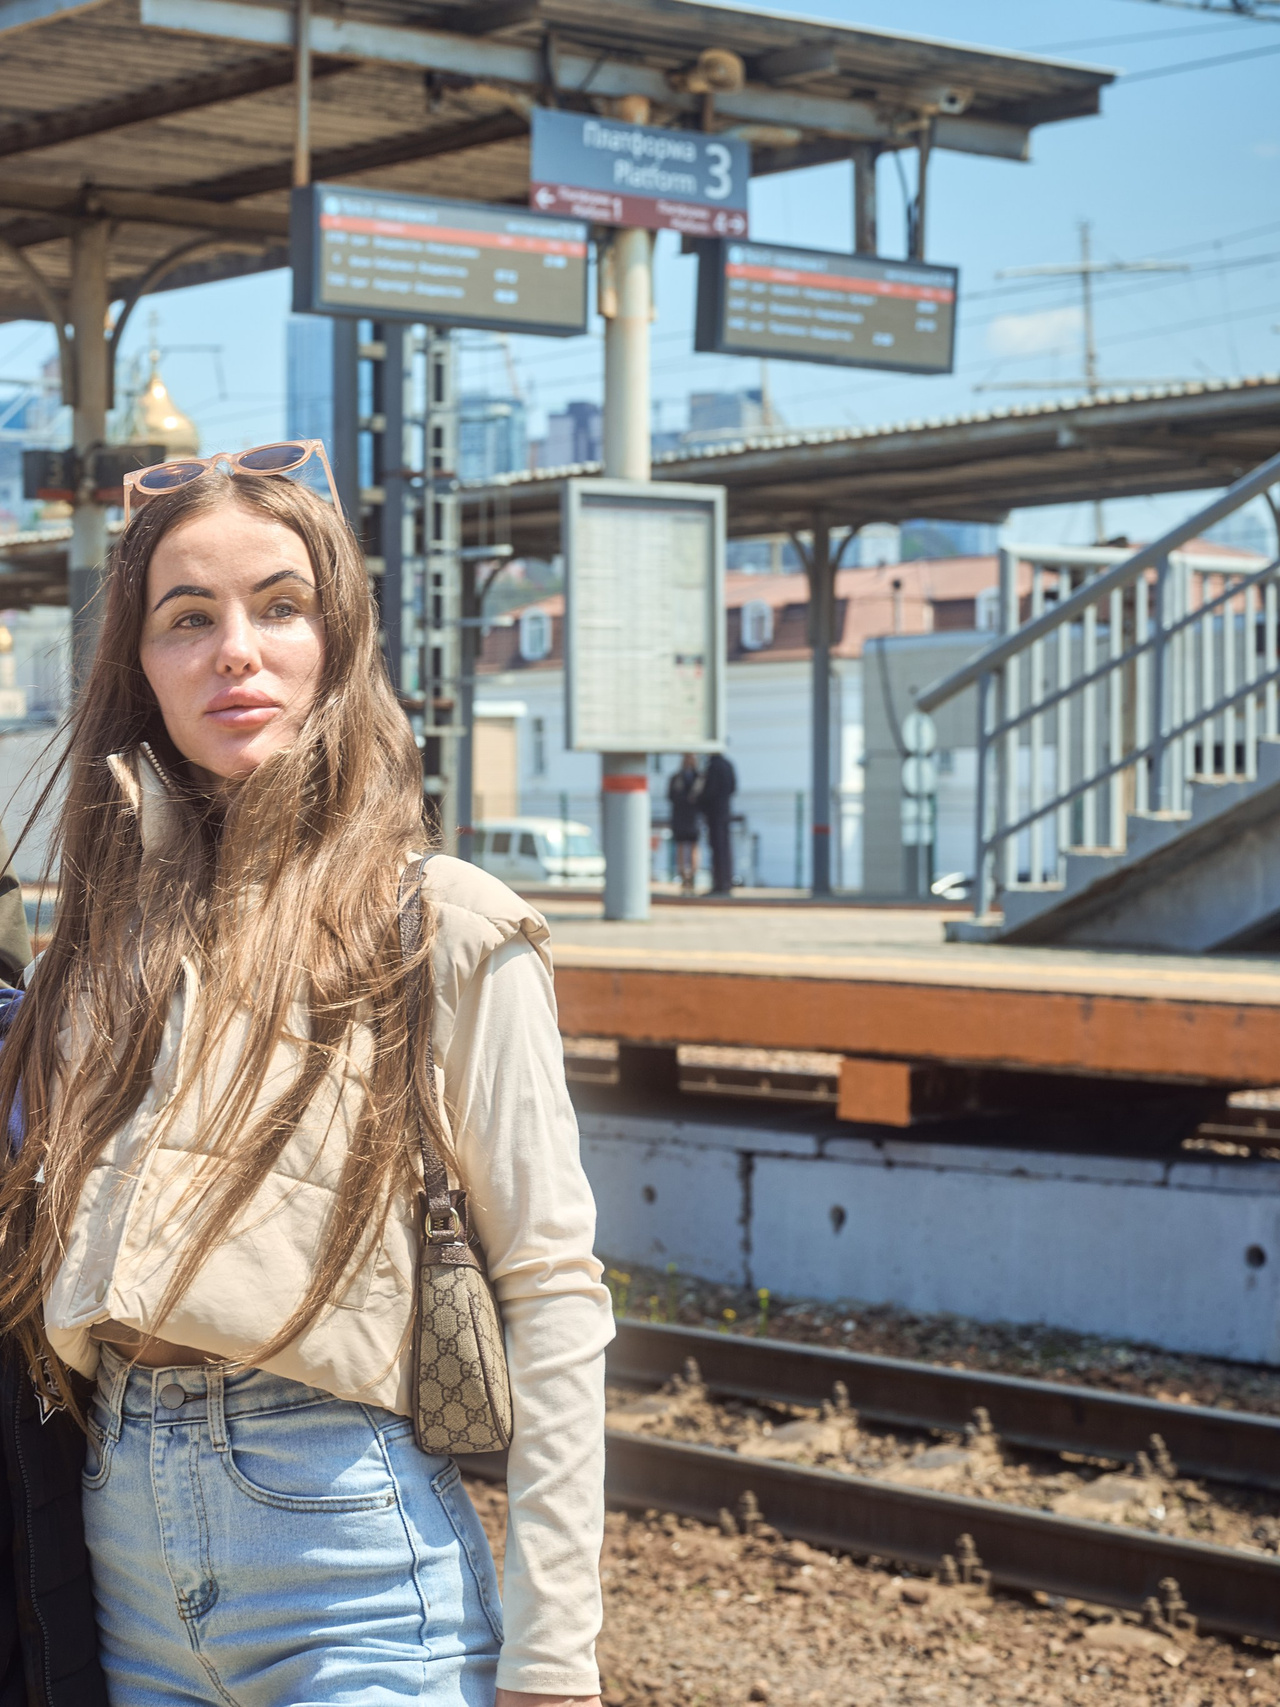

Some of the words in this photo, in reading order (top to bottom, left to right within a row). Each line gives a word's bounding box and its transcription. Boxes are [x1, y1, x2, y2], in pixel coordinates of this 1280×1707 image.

[582, 120, 698, 164] Платформа
[613, 158, 699, 196] Platform
[703, 143, 733, 200] 3
